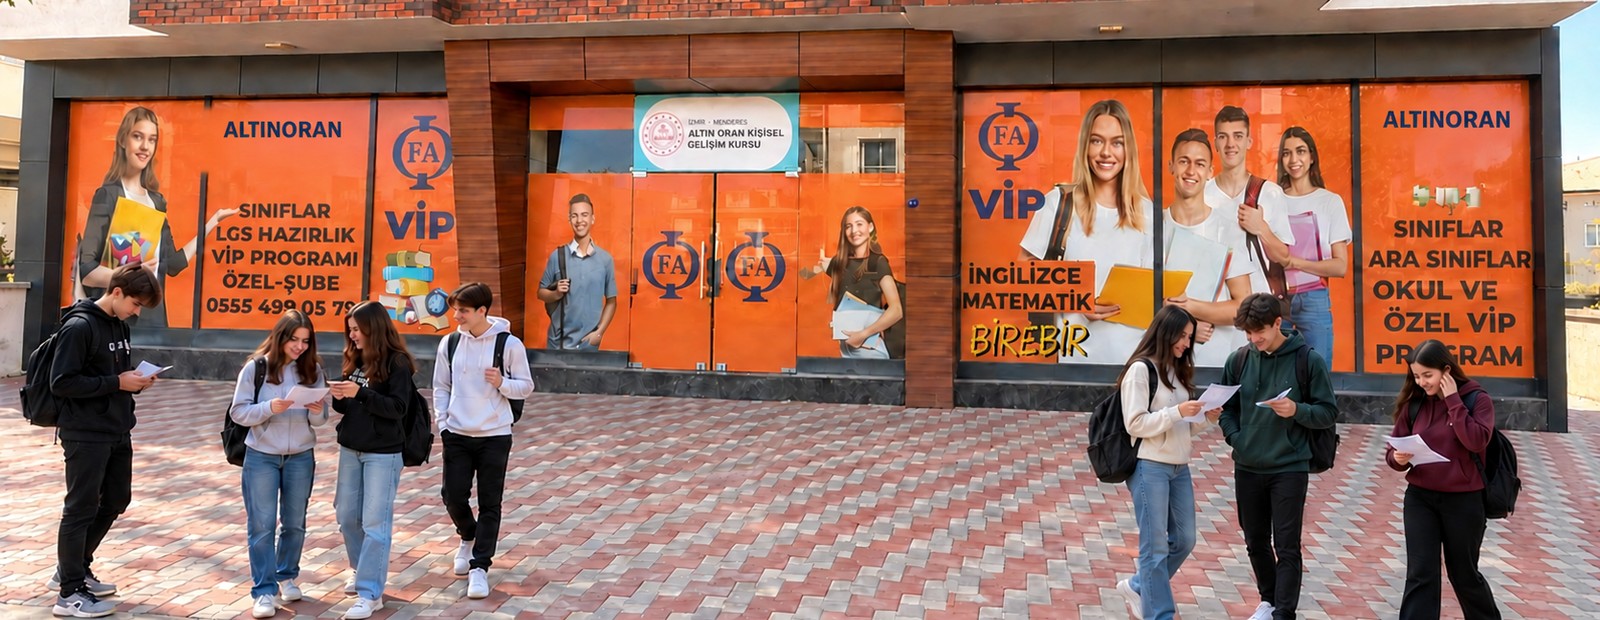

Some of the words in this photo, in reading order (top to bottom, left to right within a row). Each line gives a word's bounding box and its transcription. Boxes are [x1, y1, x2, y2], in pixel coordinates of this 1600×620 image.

[1383, 110, 1511, 128] ALTINORAN
[223, 121, 342, 138] ALTINORAN
[688, 129, 715, 138] ALTIN
[717, 129, 745, 138] ORAN
[748, 127, 784, 139] KİŞİSEL
[993, 126, 1026, 146] FA
[407, 142, 440, 163] FA
[688, 139, 726, 151] GELİŞİM
[728, 140, 761, 149] KURSU
[968, 179, 1046, 219] VİP
[239, 203, 331, 219] SINIFLAR
[384, 200, 455, 240] VİP
[215, 226, 253, 242] LGS
[258, 227, 355, 243] HAZIRLIK
[1394, 220, 1503, 238] SINIFLAR
[212, 245, 244, 265] VİP
[250, 250, 358, 267] PROGRAMI
[657, 255, 688, 275] FA
[1368, 250, 1420, 268] ARA
[1426, 250, 1532, 269] SINIFLAR
[740, 257, 773, 277] FA
[969, 261, 1081, 285] İNGİLİZCE
[222, 270, 340, 295] ÖZEL-ŞUBE
[1372, 280, 1453, 300] OKUL
[1460, 280, 1498, 301] VE
[206, 298, 253, 314] 0555
[301, 300, 326, 316] 05
[963, 289, 1092, 311] MATEMATİK
[1383, 306, 1459, 333] ÖZEL
[1467, 306, 1517, 333] VİP
[970, 318, 1090, 358] BİREBİR
[1376, 344, 1523, 367] PRRAM
